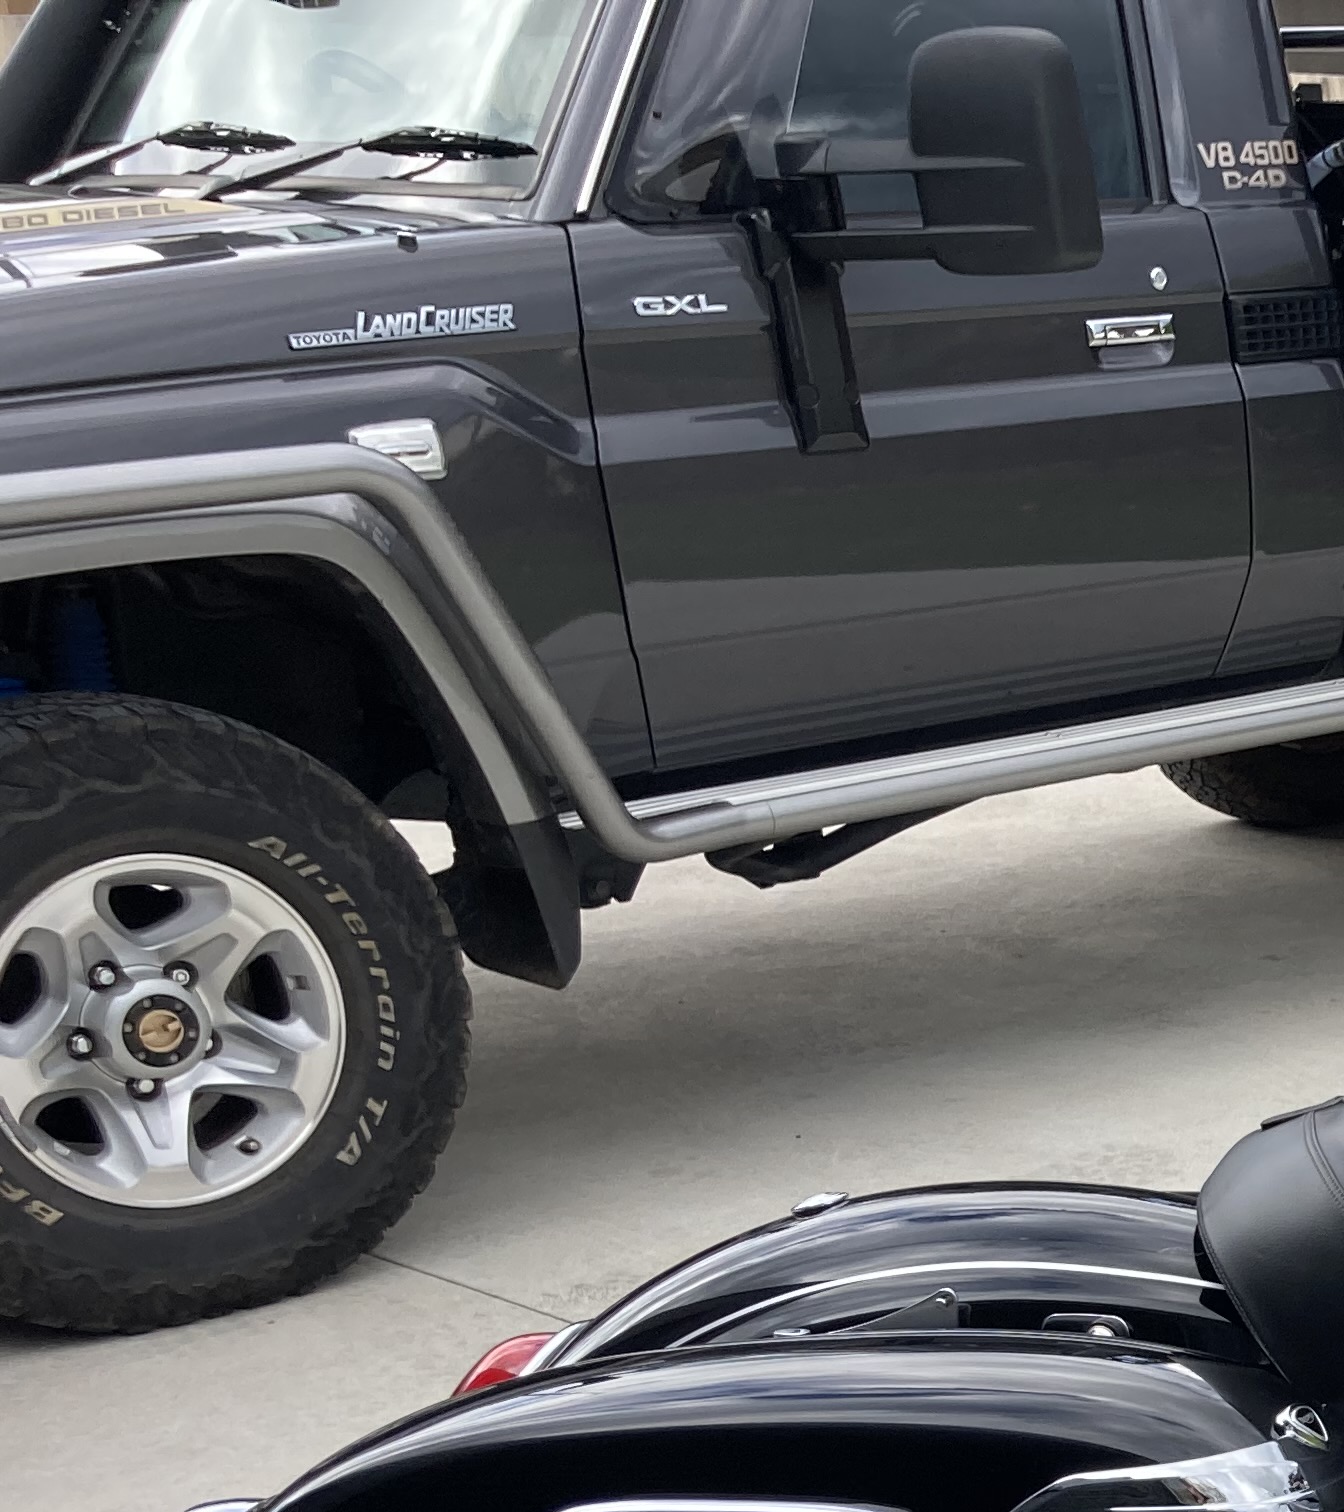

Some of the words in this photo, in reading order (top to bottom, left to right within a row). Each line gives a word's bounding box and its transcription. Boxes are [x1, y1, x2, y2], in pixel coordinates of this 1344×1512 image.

[1197, 141, 1236, 168] V8
[1239, 139, 1299, 167] 4500
[61, 203, 186, 223] DIESEL
[633, 294, 728, 317] GXL
[292, 331, 352, 346] TOYOTA
[248, 836, 401, 1072] All-Terrain
[336, 1097, 389, 1166] T/A
